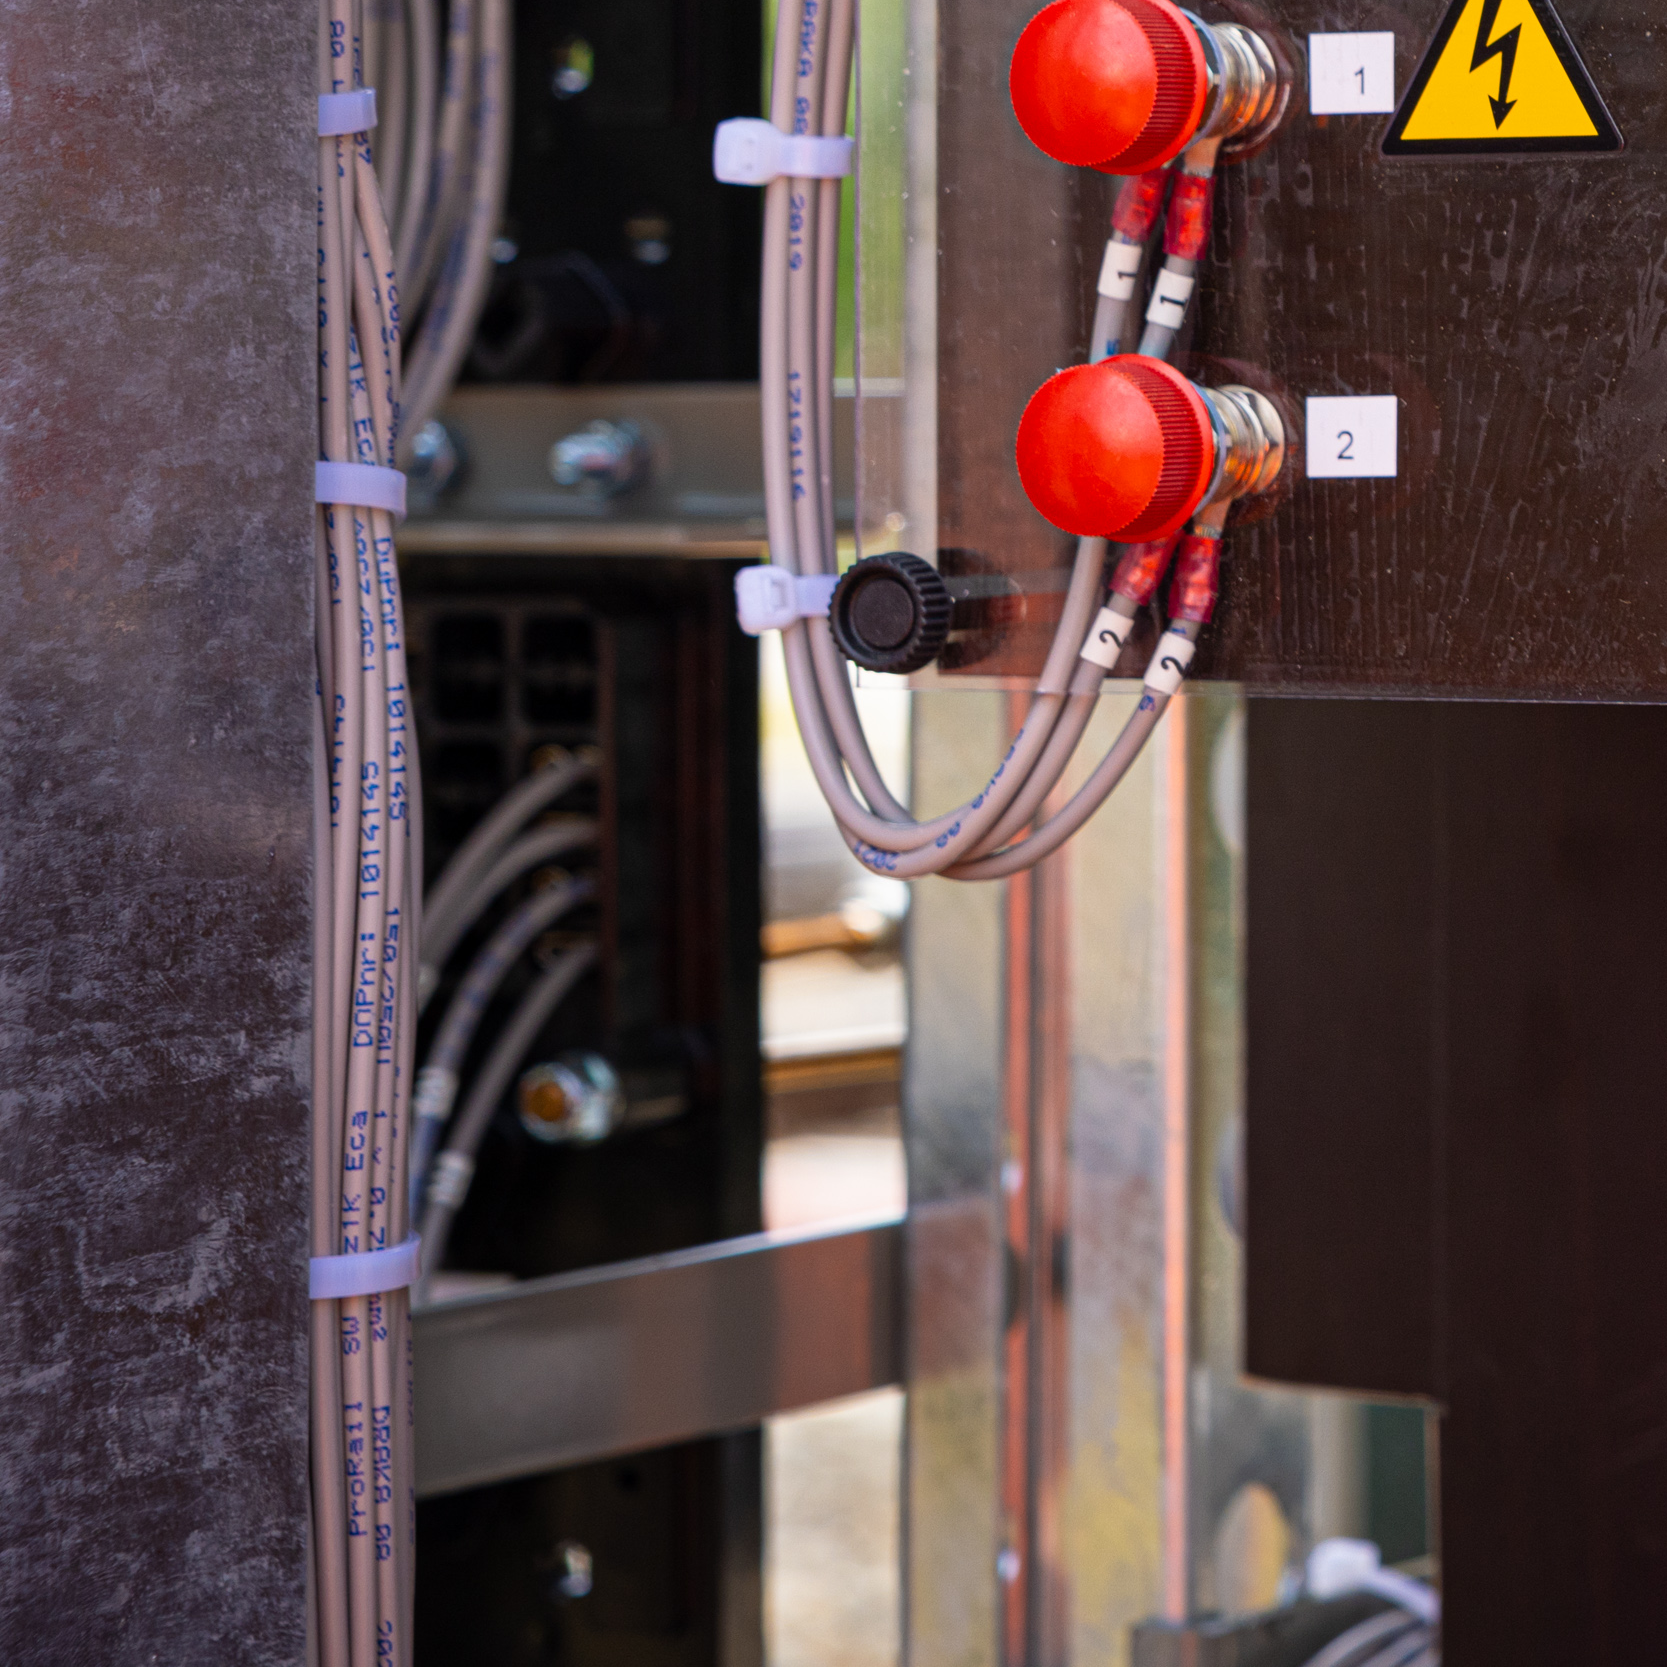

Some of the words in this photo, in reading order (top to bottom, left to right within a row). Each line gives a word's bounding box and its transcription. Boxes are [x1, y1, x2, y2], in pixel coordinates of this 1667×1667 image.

[1355, 67, 1366, 95] 1
[1160, 295, 1188, 310] 1
[1338, 430, 1355, 459] 2
[1100, 629, 1126, 648] 2
[1161, 656, 1192, 676] 2
[387, 682, 410, 820] 1014145
[361, 761, 380, 900] 1014145
[345, 1110, 369, 1172] Eca
[348, 1402, 367, 1538] ProRail
